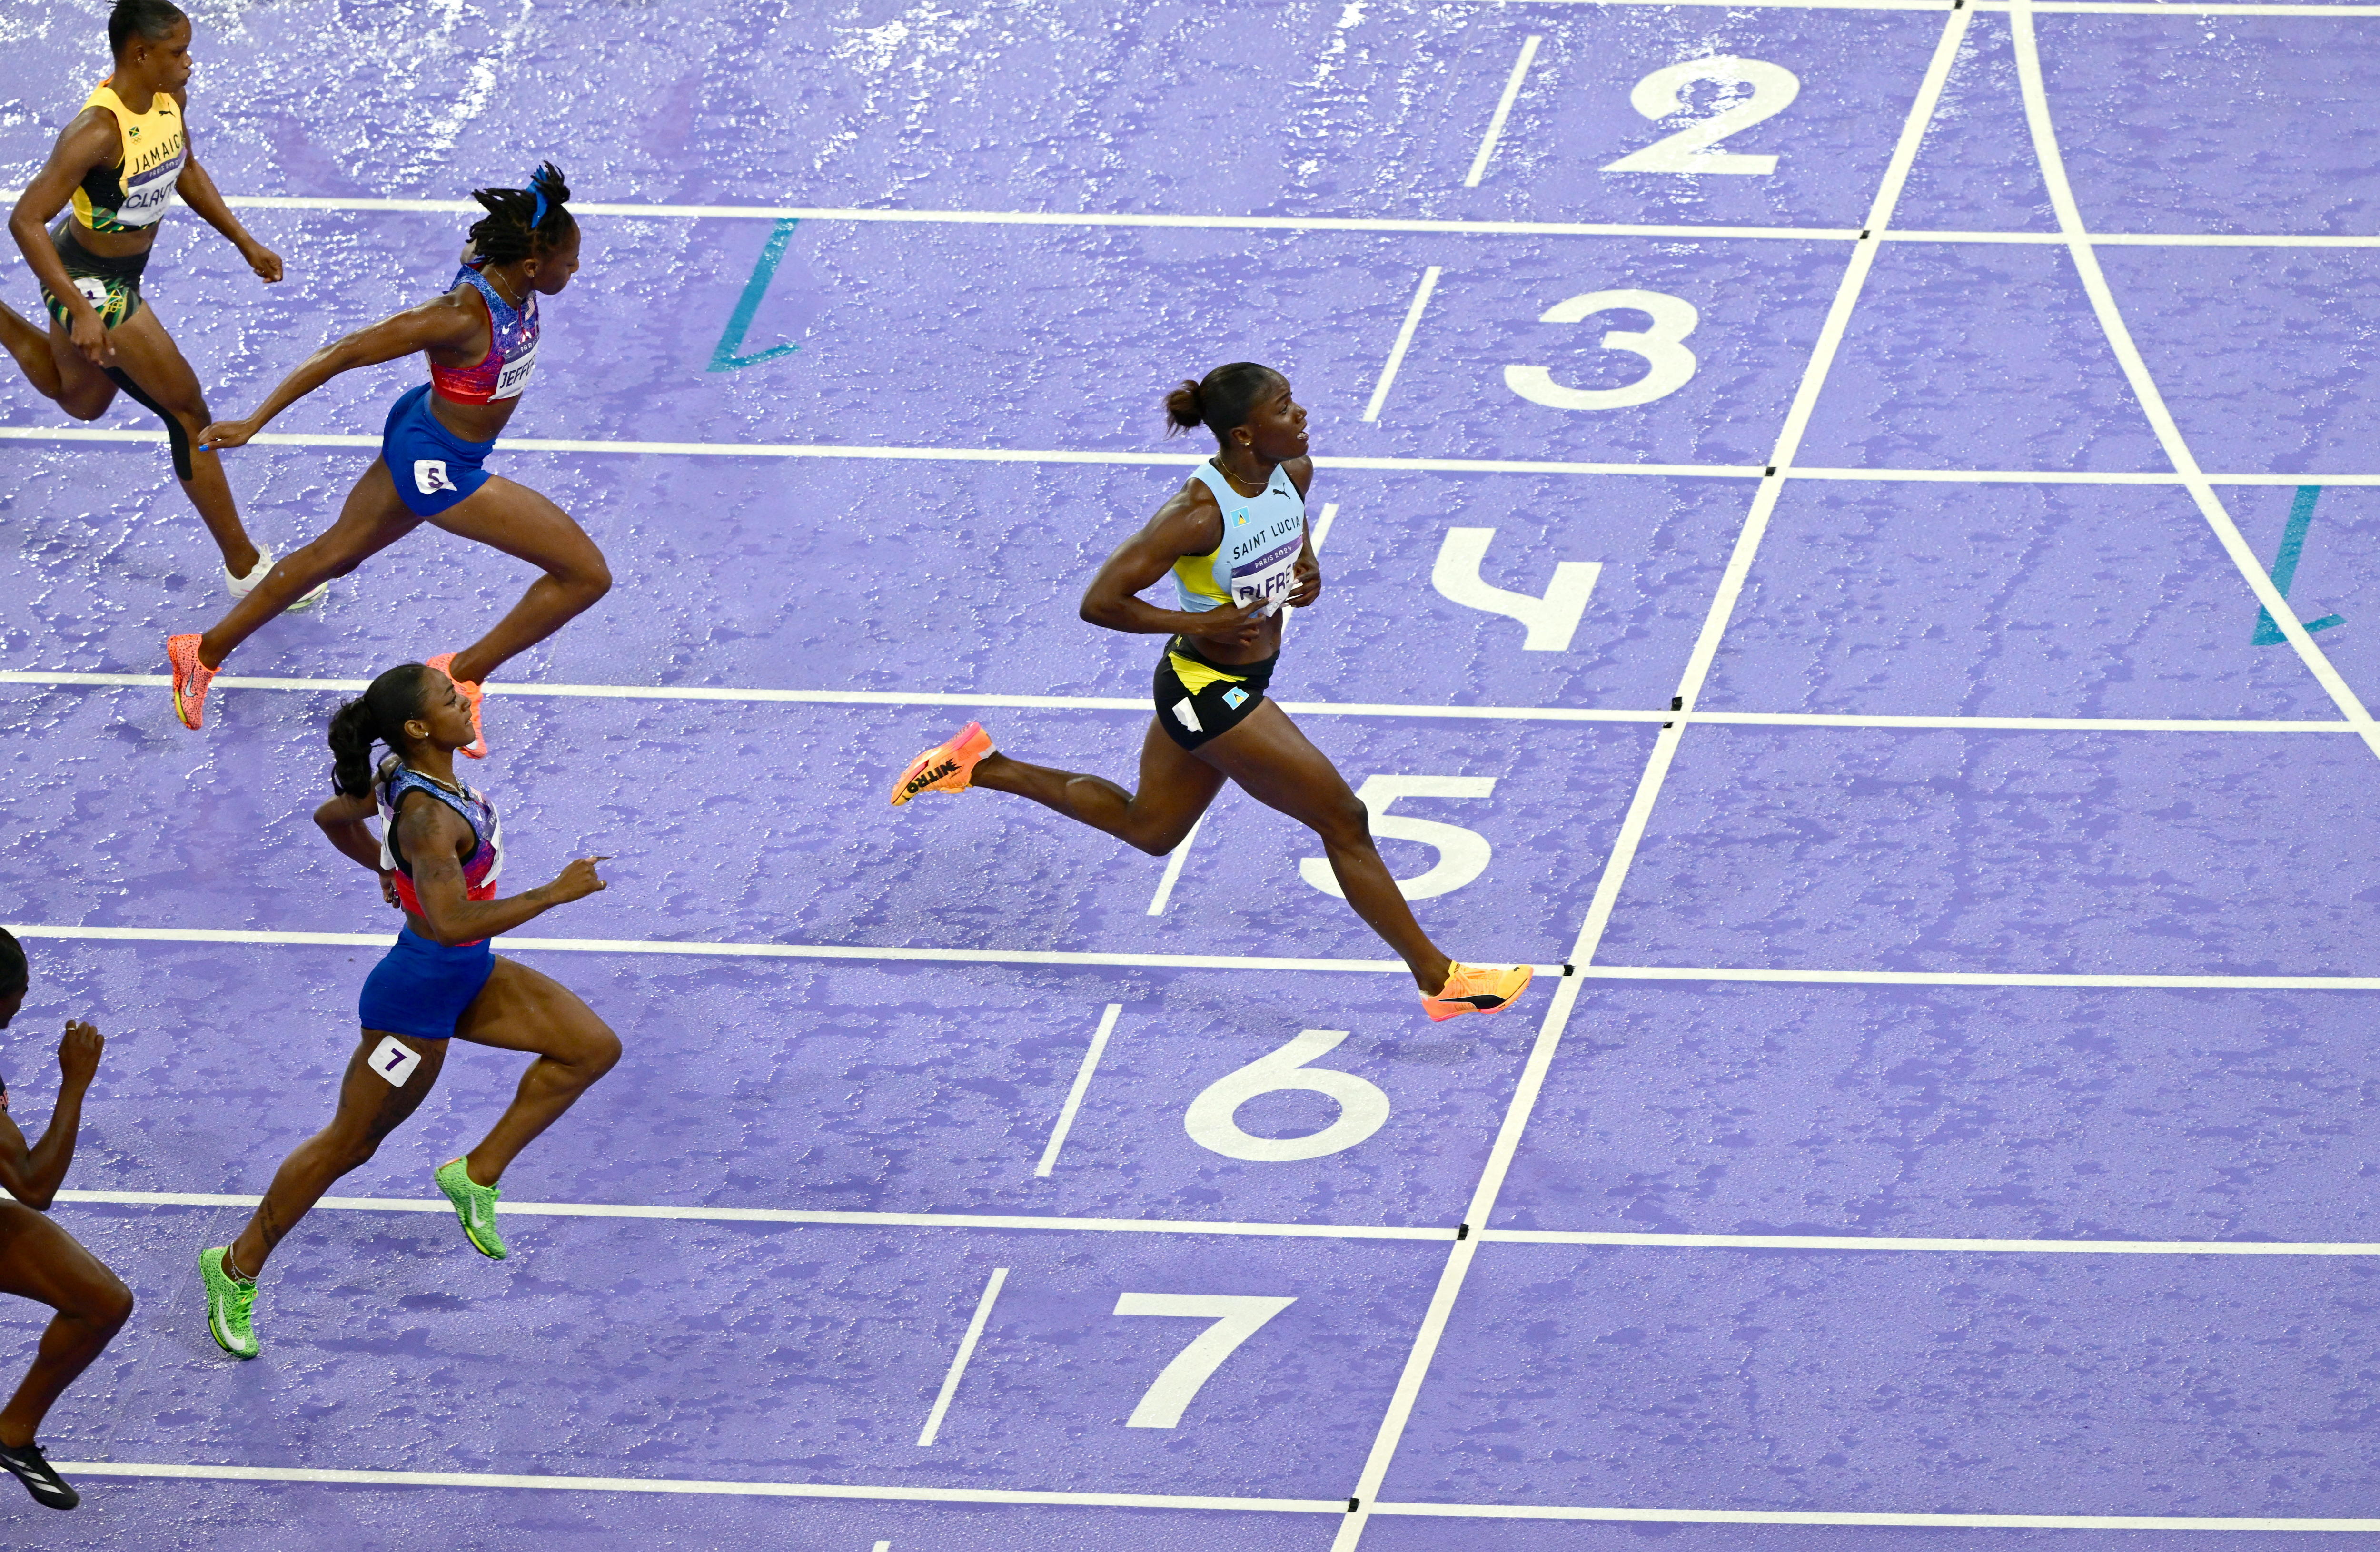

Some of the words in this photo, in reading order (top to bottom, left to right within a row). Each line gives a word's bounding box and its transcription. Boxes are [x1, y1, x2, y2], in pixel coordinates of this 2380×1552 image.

[1598, 56, 1800, 175] 2
[165, 159, 180, 169] 202
[126, 176, 177, 209] CLAYT
[1504, 289, 1698, 410] 3
[428, 468, 444, 489] 5
[1233, 530, 1265, 560] SAINT
[1271, 515, 1300, 537] LUCIA
[1255, 555, 1273, 569] PARIS
[1275, 546, 1292, 559] 2024
[1240, 562, 1295, 601] ALFRE
[1432, 527, 1603, 651] 4
[907, 758, 962, 793] NITRO
[1299, 774, 1498, 901] 5
[385, 1048, 407, 1072] 7
[1184, 1029, 1390, 1161] 6
[1113, 1292, 1298, 1428] 7
